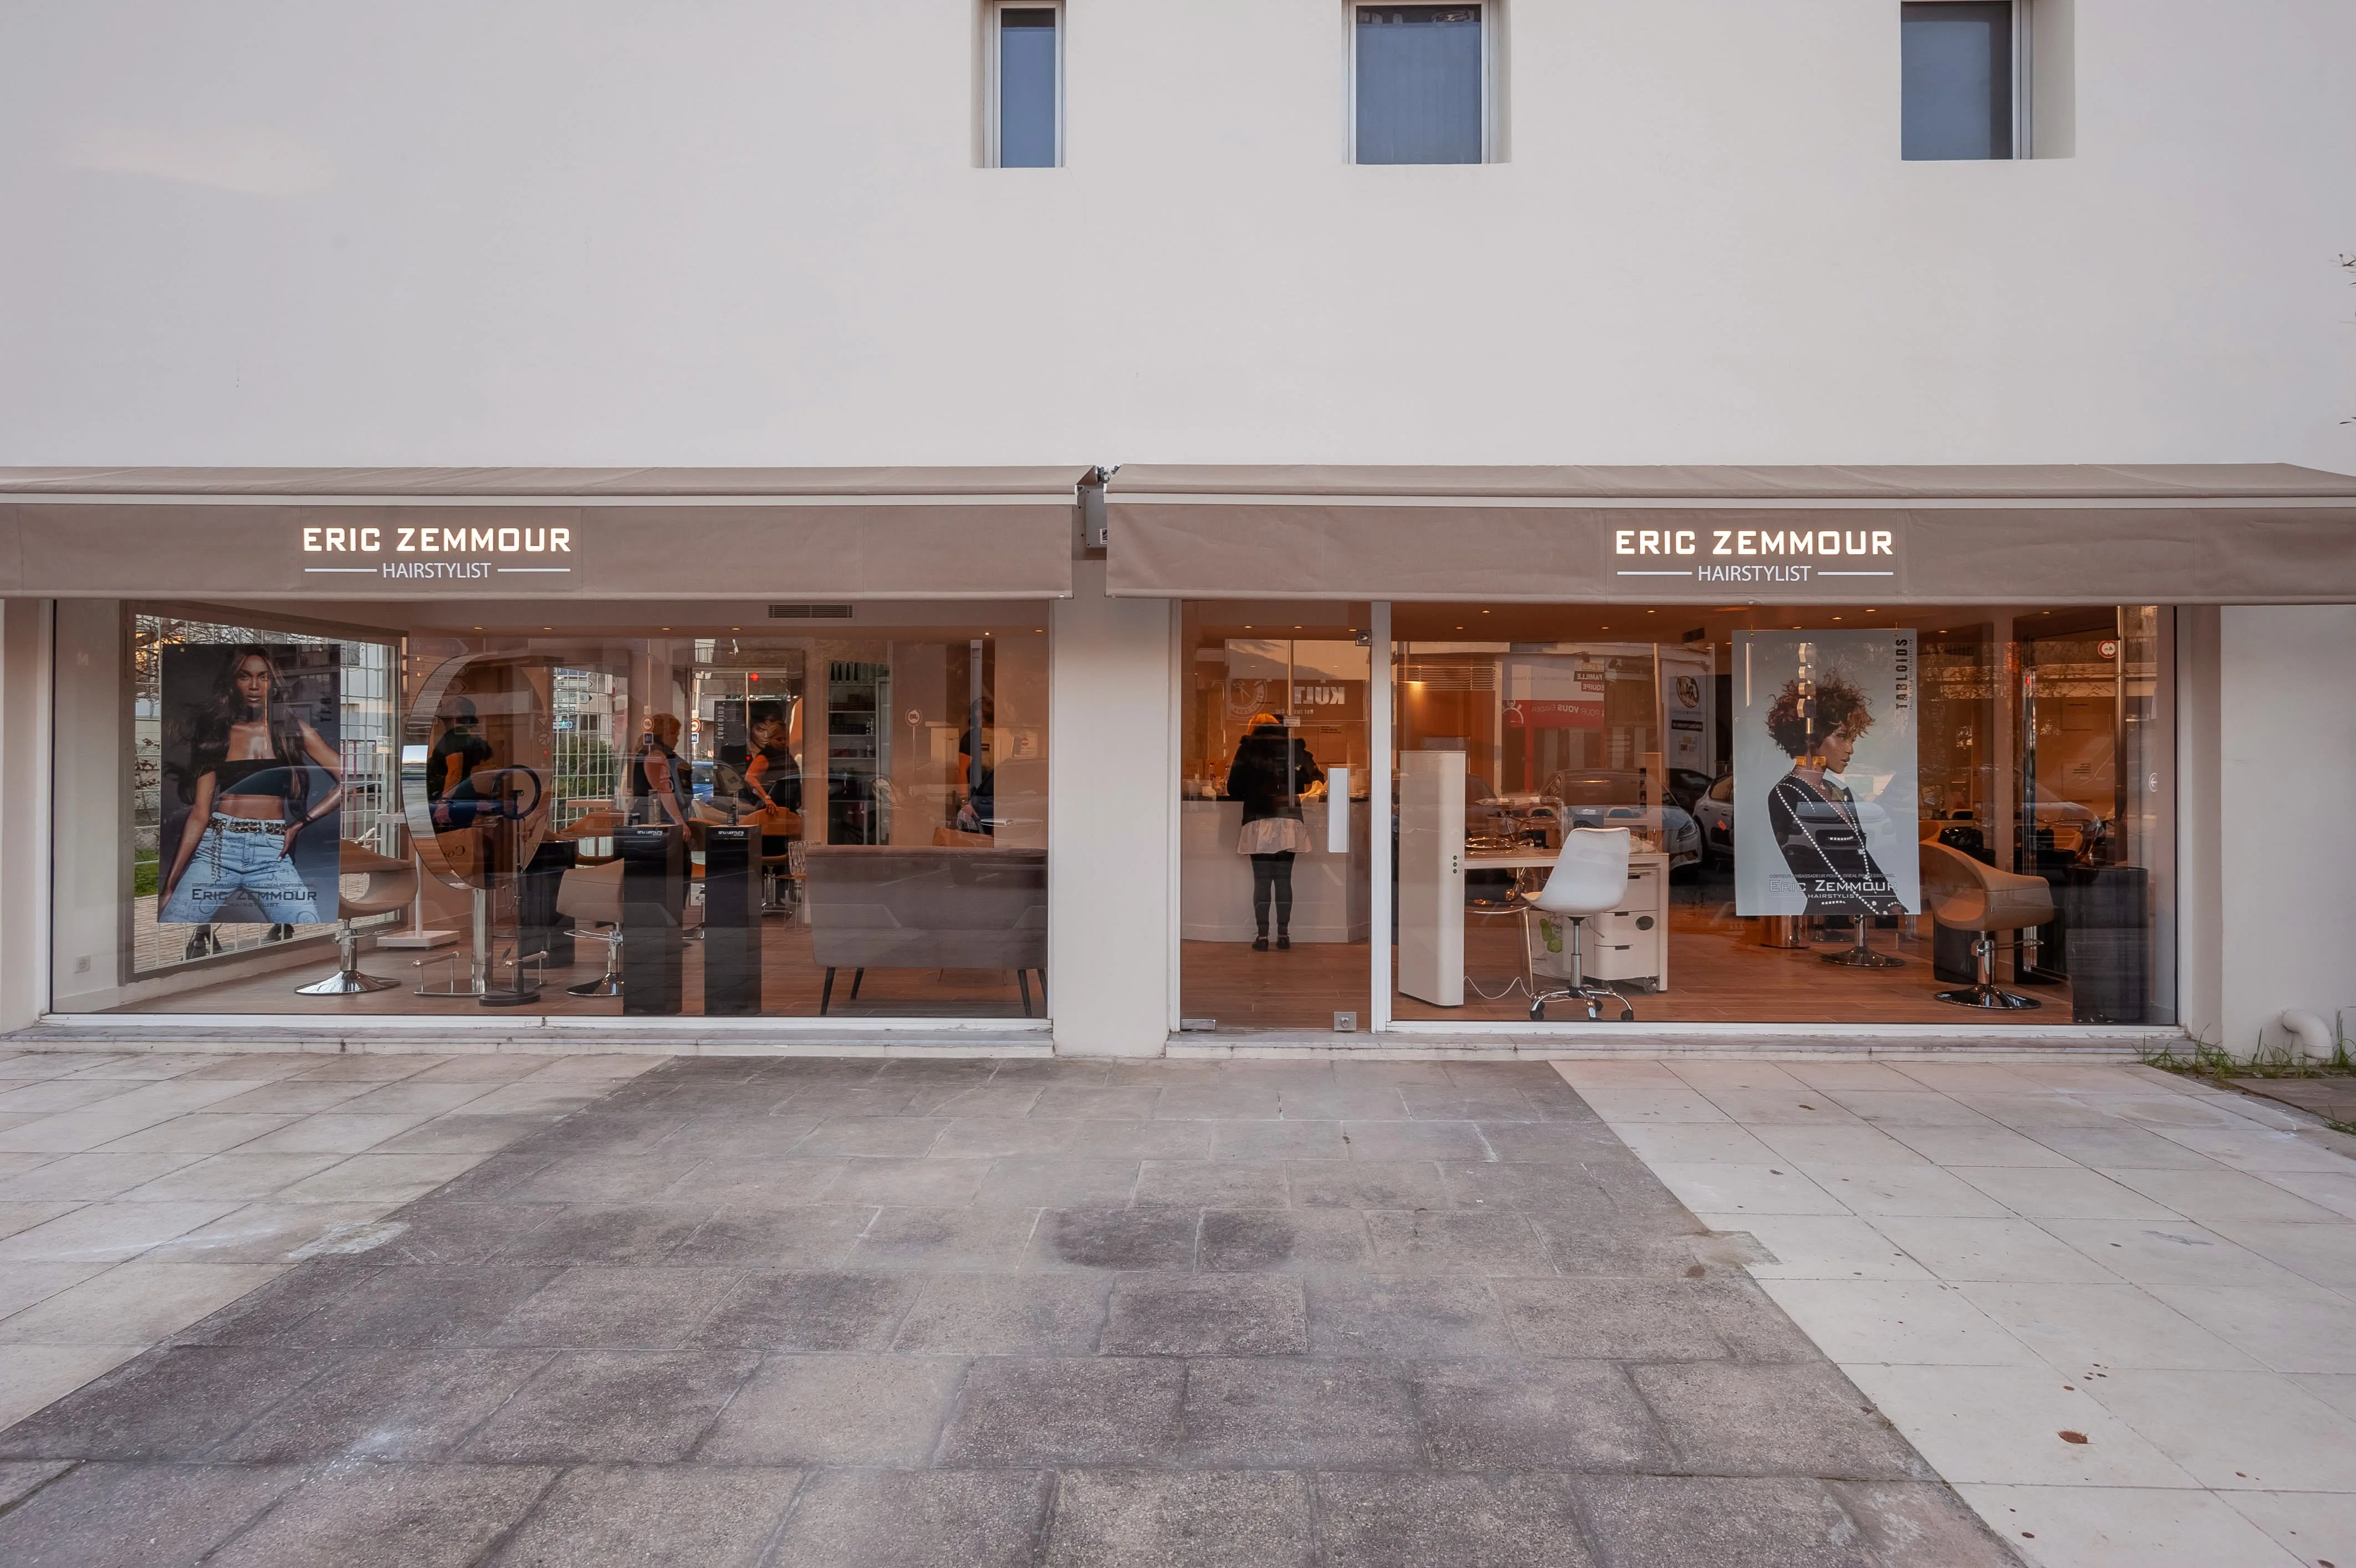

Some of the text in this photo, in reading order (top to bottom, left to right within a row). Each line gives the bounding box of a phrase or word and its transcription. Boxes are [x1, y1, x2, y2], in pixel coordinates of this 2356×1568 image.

[303, 528, 571, 551] ERIC ZEMMOUR
[1616, 530, 1893, 555] ERIC ZEMMOUR
[382, 563, 492, 578] HAIRSTYLIST
[1698, 565, 1812, 581] HAIRSTYLIST
[1895, 639, 1908, 710] TABLOIDS
[192, 888, 228, 900] ERIC
[1769, 880, 1898, 892] ERIC ZEMMOUR
